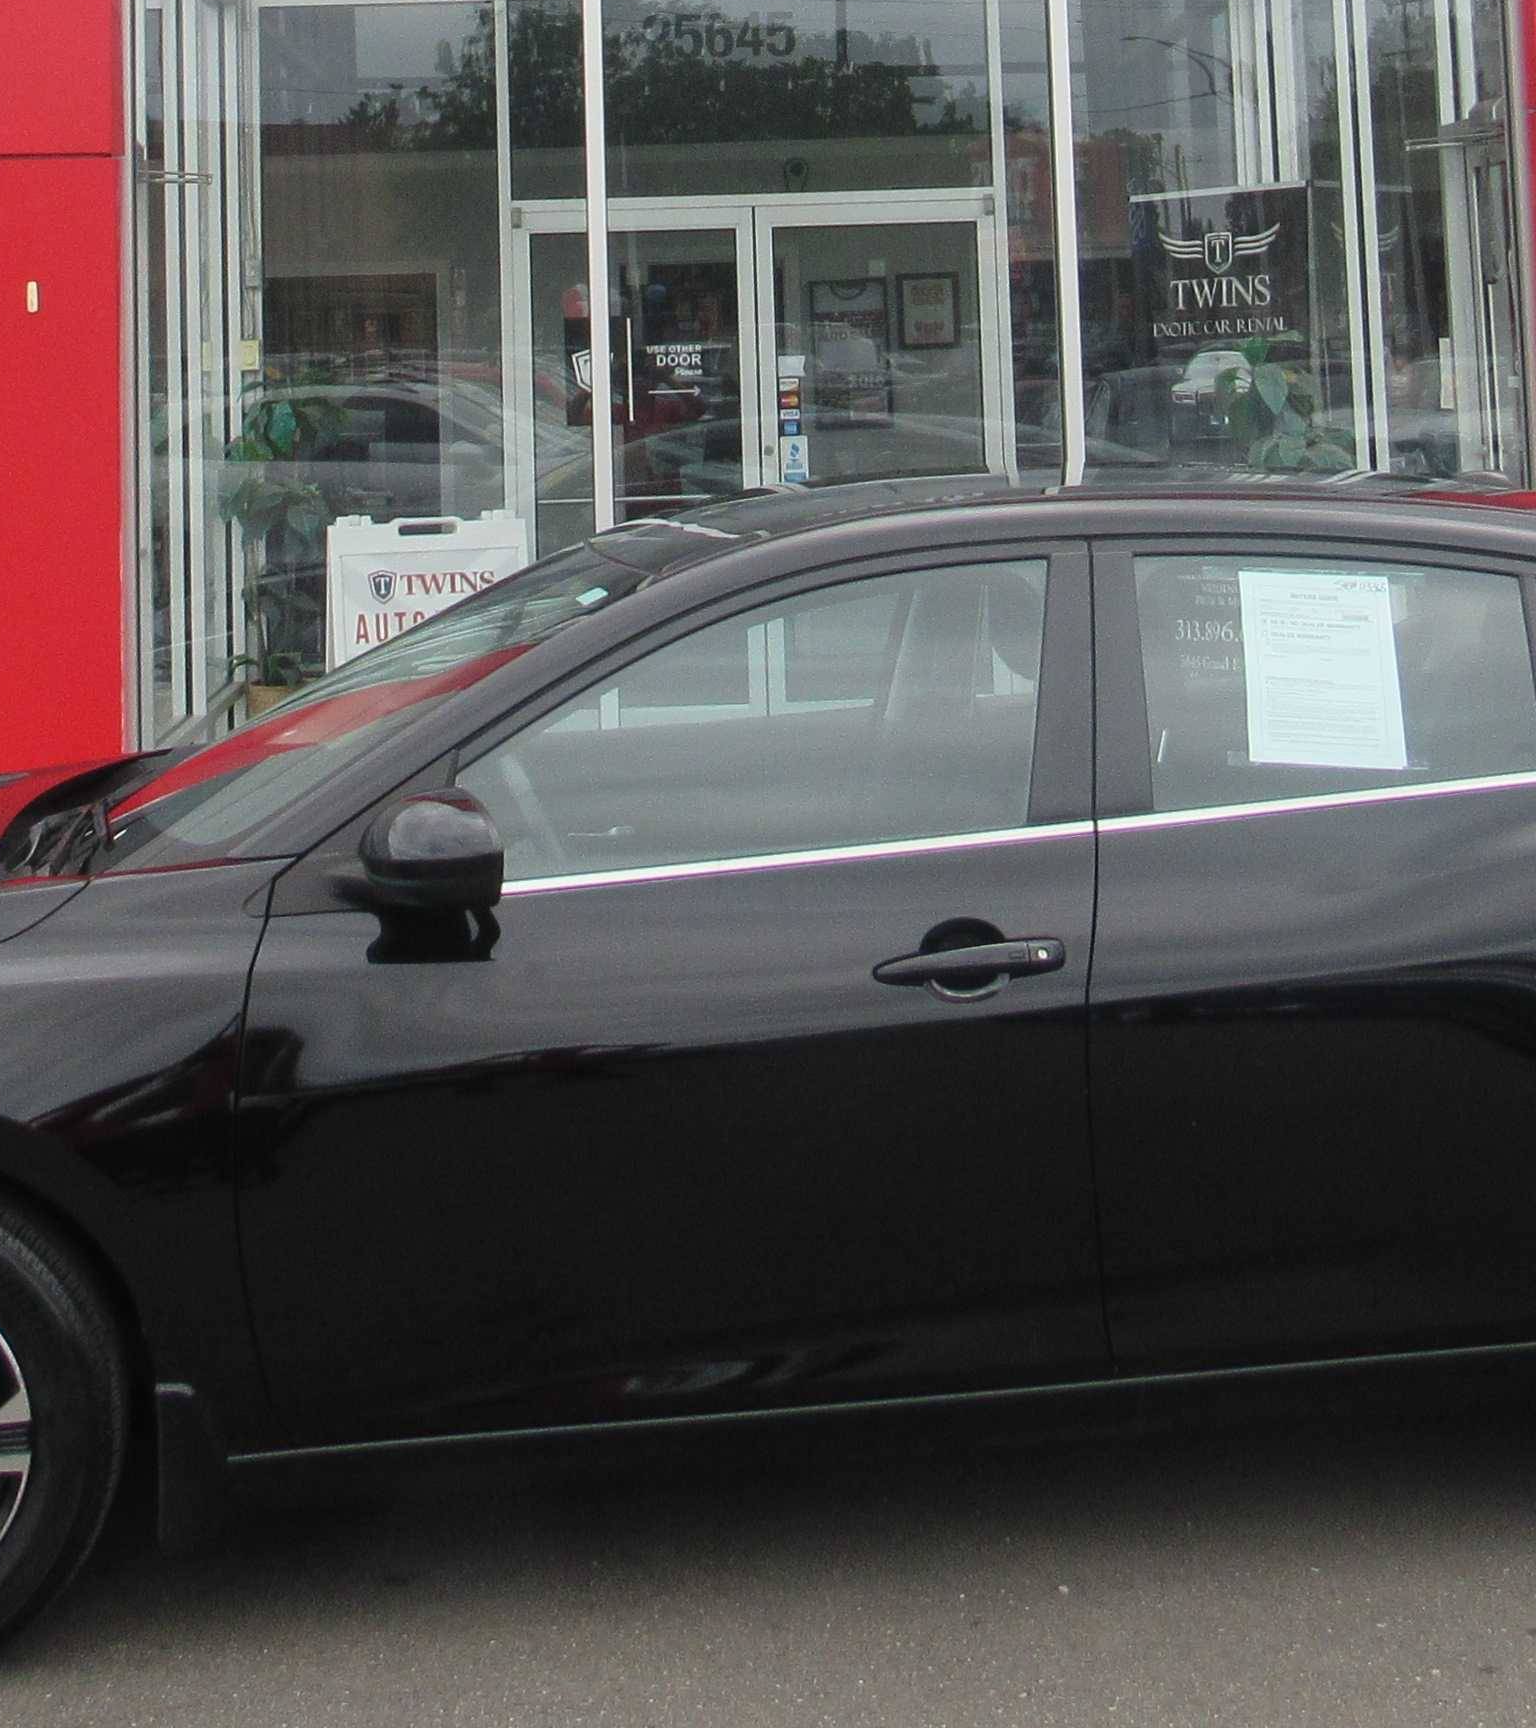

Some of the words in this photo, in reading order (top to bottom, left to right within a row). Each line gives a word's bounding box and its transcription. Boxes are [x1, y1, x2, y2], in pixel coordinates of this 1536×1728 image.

[1169, 274, 1272, 310] TWINS
[1153, 321, 1202, 338] EXOTIC
[1203, 318, 1233, 334] CAR
[1237, 316, 1288, 334] RENTAL
[646, 345, 666, 354] USE
[668, 344, 703, 353] OTHER
[656, 353, 702, 367] DOOR
[400, 570, 496, 595] TWINS
